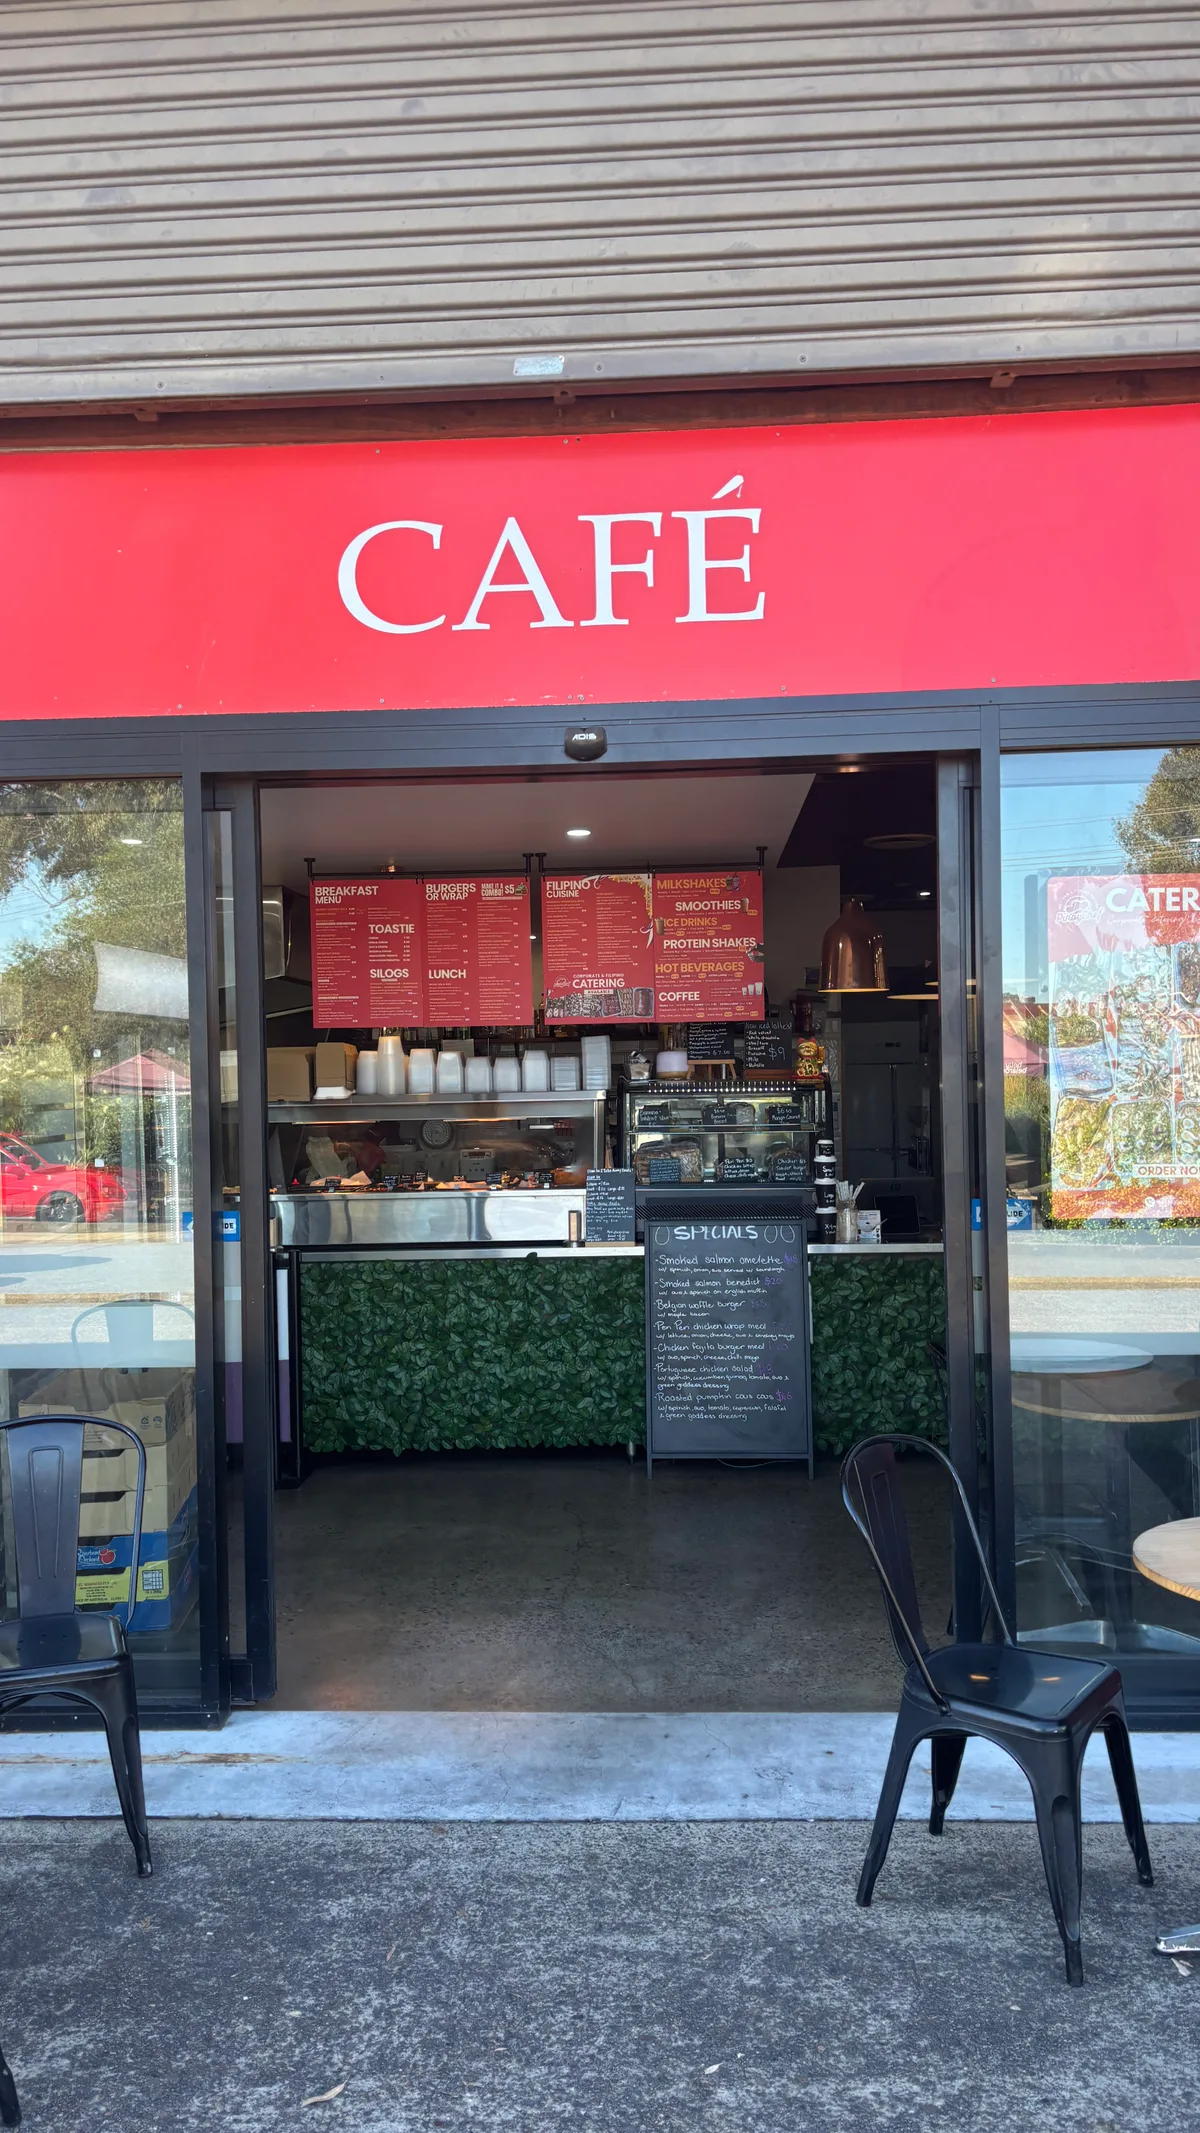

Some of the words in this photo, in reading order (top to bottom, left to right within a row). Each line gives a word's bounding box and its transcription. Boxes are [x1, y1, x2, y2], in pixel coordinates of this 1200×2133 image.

[338, 474, 765, 635] CAFÉ
[426, 883, 476, 893] BURGERS
[546, 880, 591, 891] FILIPINO
[656, 878, 727, 889] MILKSHAKES
[314, 886, 379, 896] BREAKFAST
[482, 888, 504, 897] COMBO!
[504, 884, 515, 894] $5
[546, 890, 580, 898] CUISINE
[315, 896, 342, 904] MENU
[426, 893, 439, 901] OR
[440, 892, 469, 900] WRAP
[1106, 886, 1200, 913] CATER
[675, 900, 741, 912] SMOOTHIES
[664, 918, 680, 927] ICE
[681, 917, 718, 927] DRINKS
[368, 924, 415, 934] TOASTIE
[663, 939, 710, 949] PROTEIN
[712, 938, 756, 948] SHAKES
[655, 963, 679, 974] HOT
[680, 962, 745, 973] BEVERAGES
[370, 968, 410, 979] SILOGS
[428, 969, 467, 979] LUNCH
[572, 978, 625, 988] CATERING
[659, 992, 700, 1002] COFFEE
[769, 1044, 786, 1061] $9
[1138, 1166, 1177, 1176] ORDER
[1180, 1166, 1200, 1176] NO
[674, 1226, 759, 1240] SPECIALS
[705, 1254, 735, 1264] salmon
[740, 1255, 784, 1265] omelette
[756, 1266, 785, 1274] sourdough
[726, 1277, 760, 1286] benedict
[764, 1276, 782, 1286] $20
[725, 1289, 746, 1297] english
[689, 1301, 715, 1309] waffle
[718, 1301, 746, 1312] burger
[692, 1342, 715, 1354] fajita
[718, 1344, 745, 1354] burger
[732, 1365, 754, 1373] salad
[703, 1383, 730, 1392] dressing
[696, 1392, 732, 1403] pumpkin
[688, 1413, 716, 1422] goddess
[718, 1413, 748, 1422] dressing
